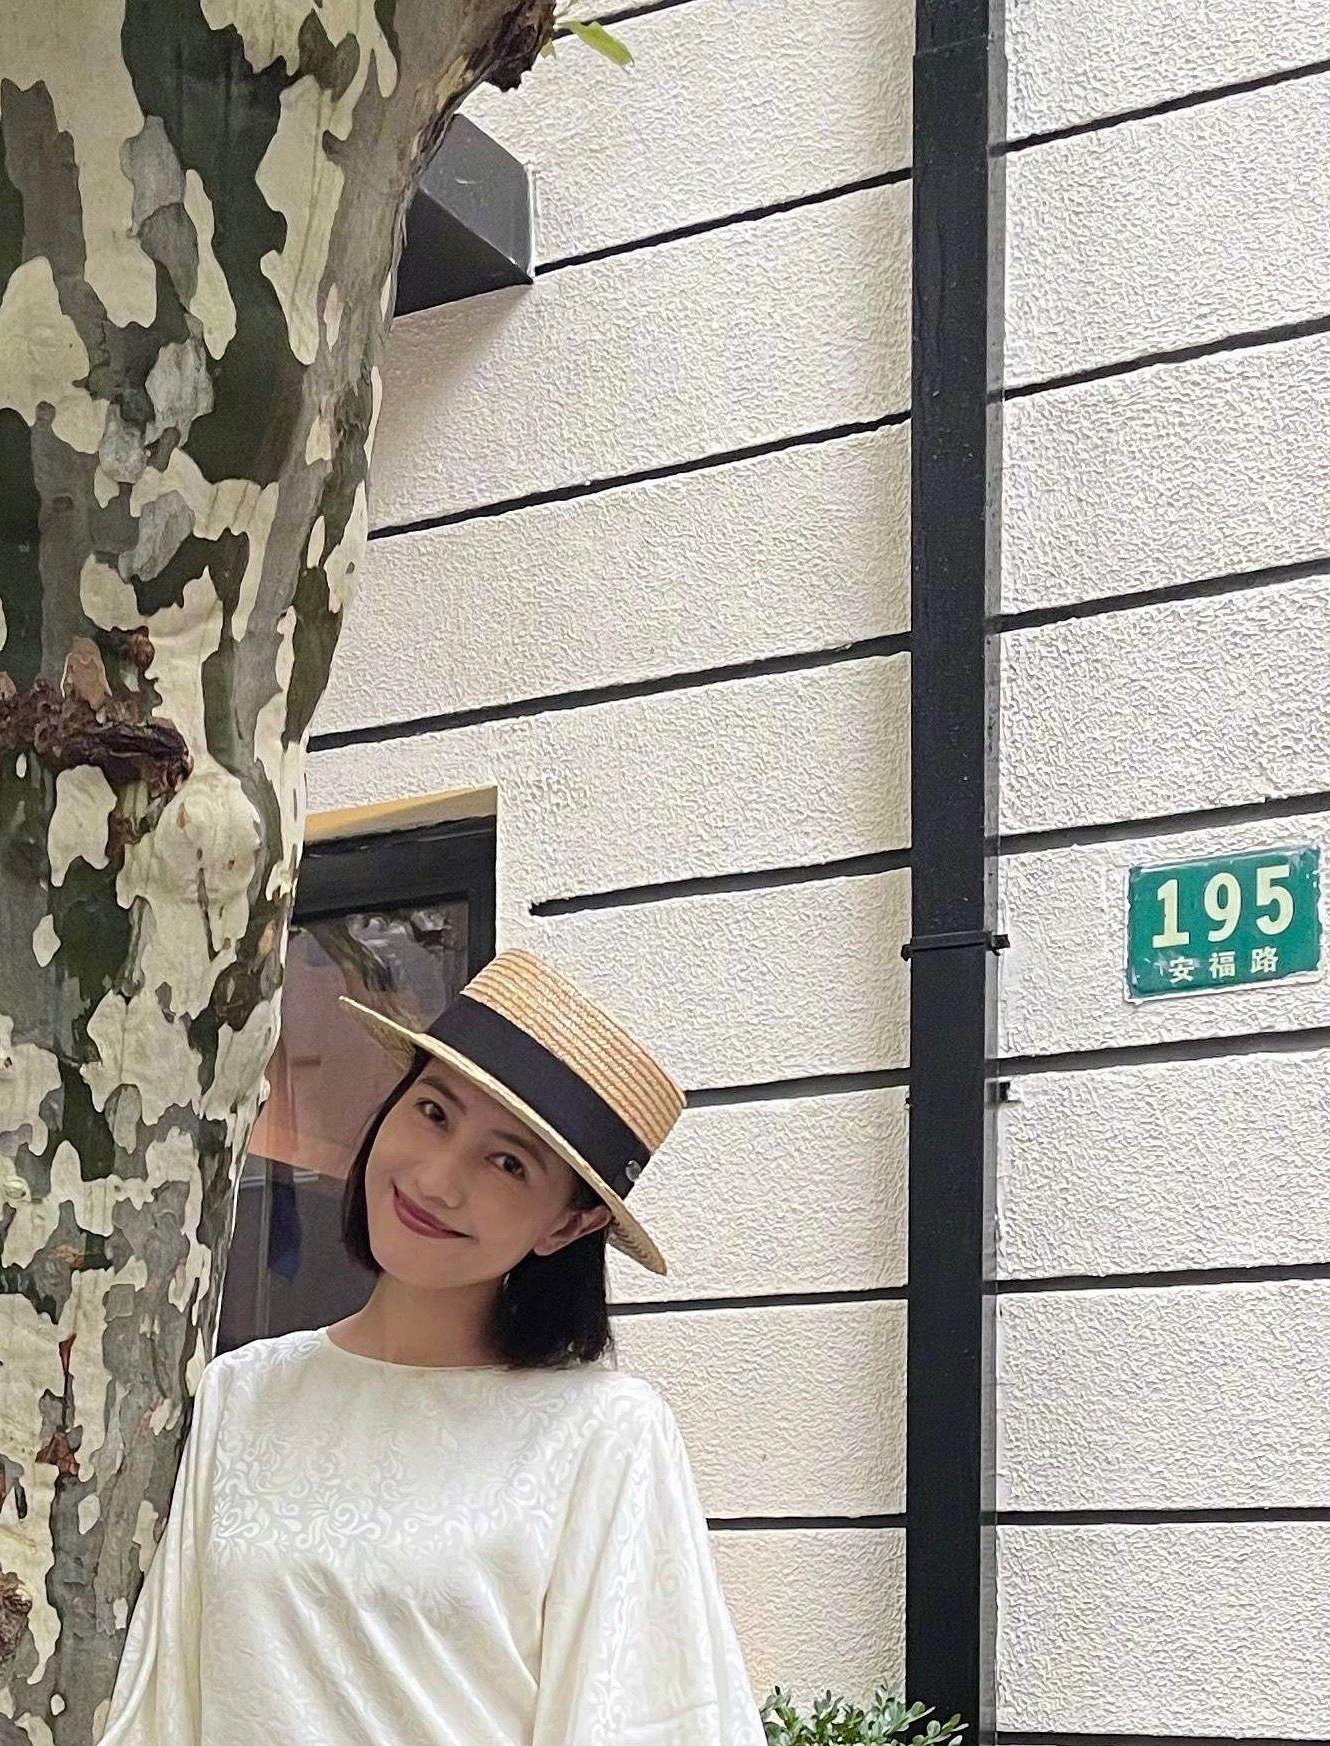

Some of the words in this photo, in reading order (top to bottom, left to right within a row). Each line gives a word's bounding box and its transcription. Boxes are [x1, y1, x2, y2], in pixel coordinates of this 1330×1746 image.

[1151, 864, 1295, 949] 195
[1168, 946, 1279, 983] 安福路
